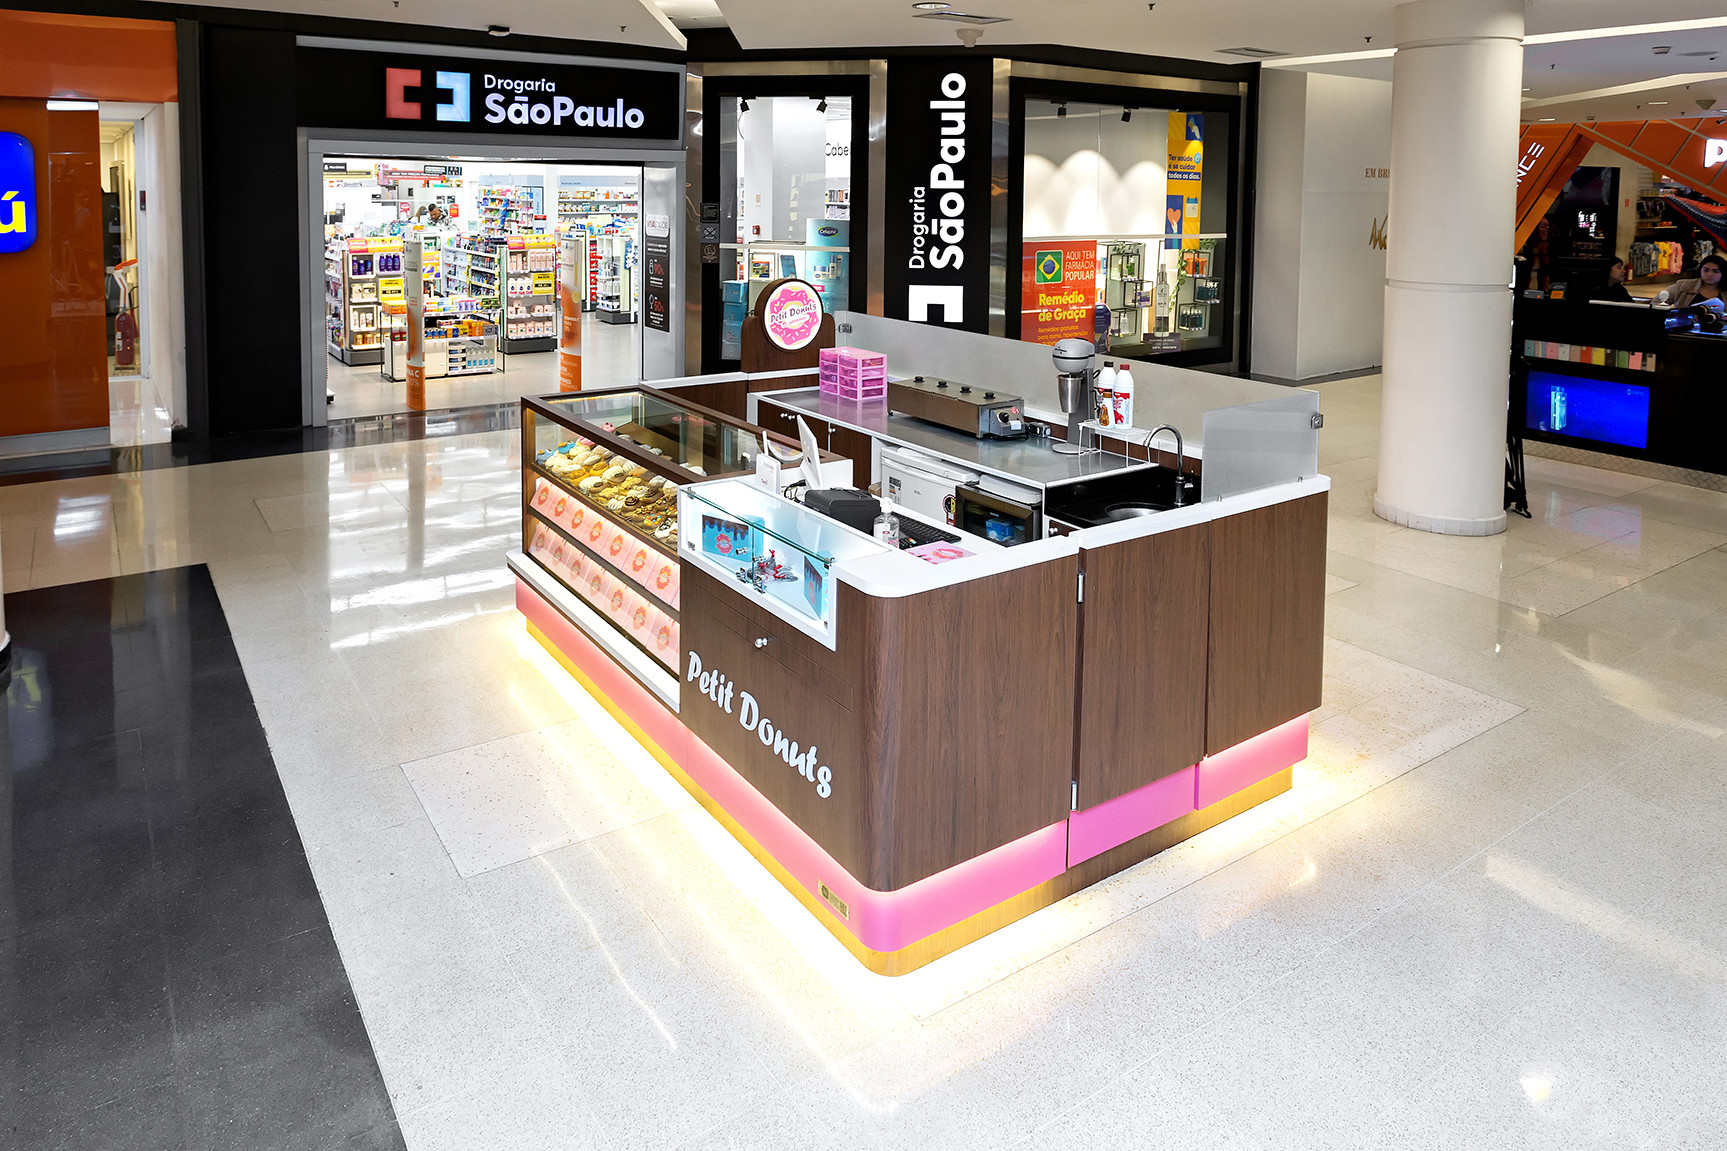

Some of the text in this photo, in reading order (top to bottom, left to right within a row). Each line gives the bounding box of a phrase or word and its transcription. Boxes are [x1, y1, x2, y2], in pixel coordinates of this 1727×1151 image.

[484, 74, 556, 93] Drogaria
[1365, 168, 1376, 178] EM
[909, 187, 929, 269] Drogaria
[1066, 250, 1095, 260] AQUI TEM
[1065, 260, 1094, 270] FARMÁCIA
[1065, 270, 1094, 280] POPULAR
[1038, 290, 1085, 306] Remédio
[770, 312, 787, 323] Petit
[789, 302, 817, 317] Donuts
[1038, 308, 1086, 322] de Graça
[687, 650, 832, 799] Petit Donuts
